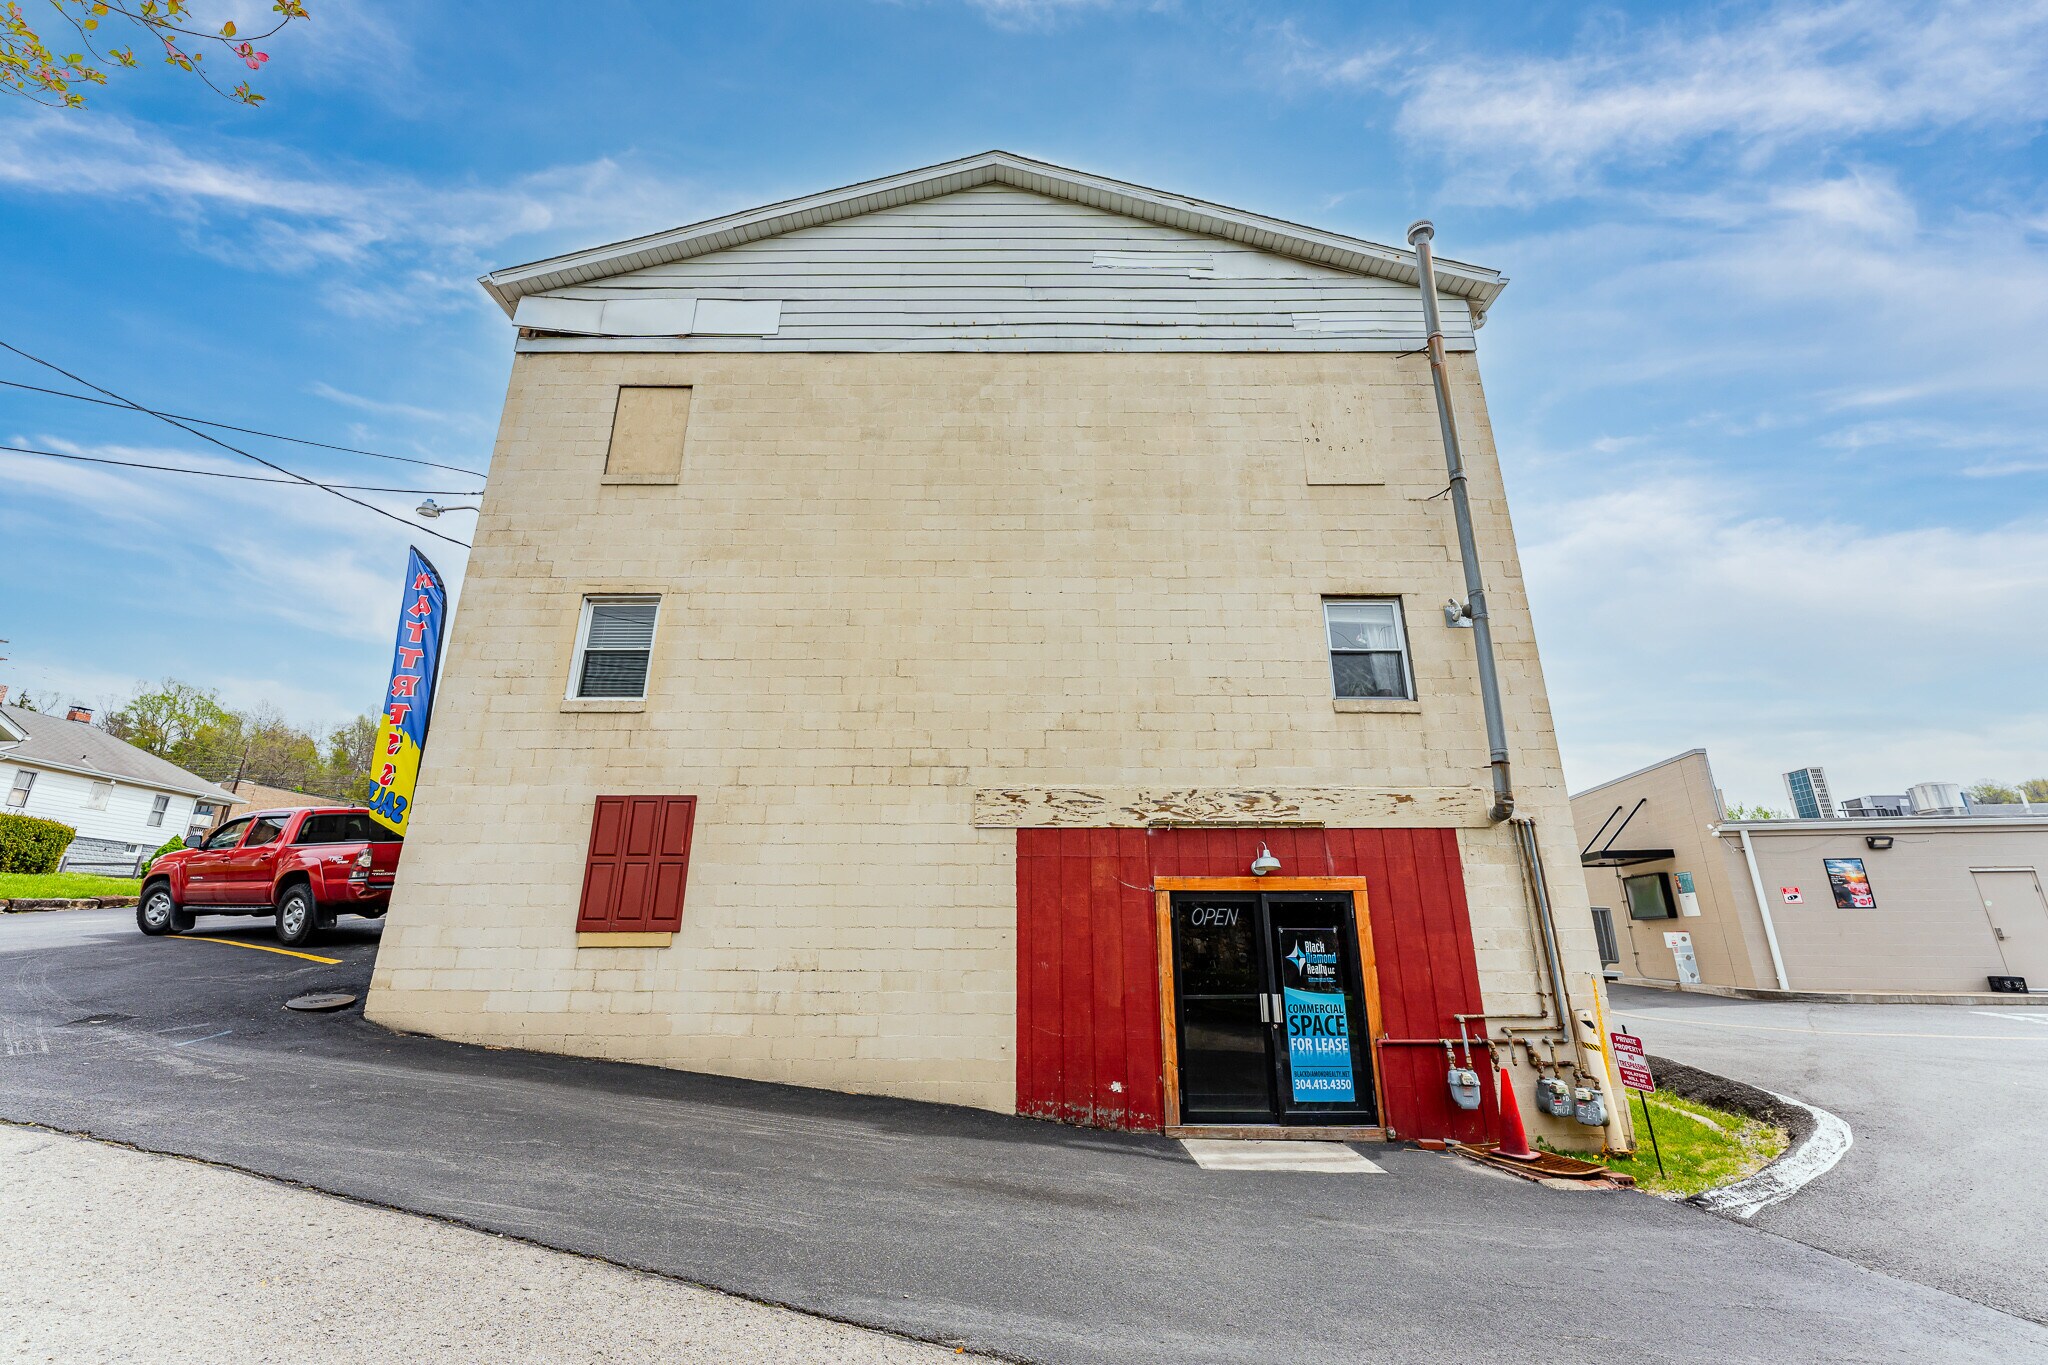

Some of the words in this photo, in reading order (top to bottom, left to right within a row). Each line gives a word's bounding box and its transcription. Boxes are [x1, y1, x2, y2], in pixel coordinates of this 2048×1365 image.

[1191, 907, 1239, 926] OPEN
[1304, 940, 1326, 953] Black
[1305, 951, 1337, 964] Diamond
[1306, 963, 1328, 977] Realty
[1287, 1003, 1344, 1014] COMMERCIAL
[1289, 1014, 1347, 1036] SPACE
[1290, 1037, 1313, 1051] FOR
[1315, 1037, 1349, 1051] LEASE
[1615, 1035, 1637, 1046] PRIVATE
[1613, 1042, 1642, 1055] PROPERTY
[1619, 1059, 1650, 1073] TRESPASSING
[1623, 1070, 1648, 1080] VIOLATORS
[1295, 1078, 1352, 1090] 304.413.4350
[1622, 1079, 1653, 1091] PROSECUTED
